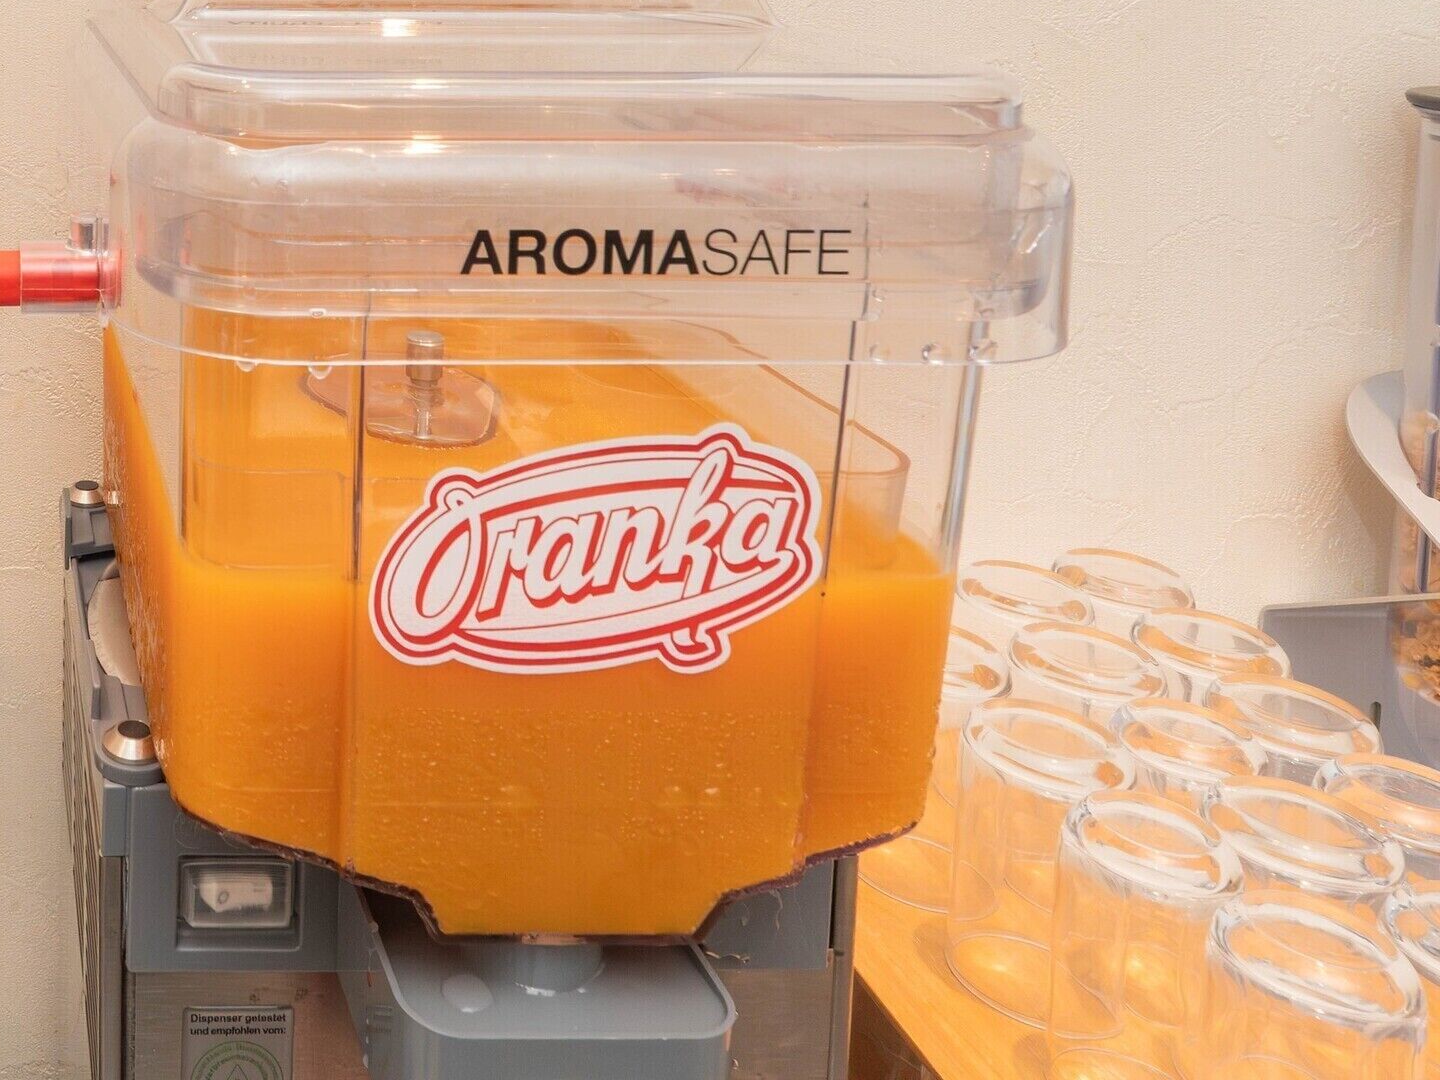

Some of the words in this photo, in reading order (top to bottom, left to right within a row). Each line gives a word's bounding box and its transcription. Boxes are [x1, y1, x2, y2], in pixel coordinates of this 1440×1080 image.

[459, 227, 853, 276] AROMASAFE
[386, 445, 801, 660] Oranka
[190, 1013, 242, 1024] Dispenser
[190, 1027, 209, 1036] und
[210, 1026, 261, 1037] empfohlen
[262, 1027, 287, 1035] vom:
